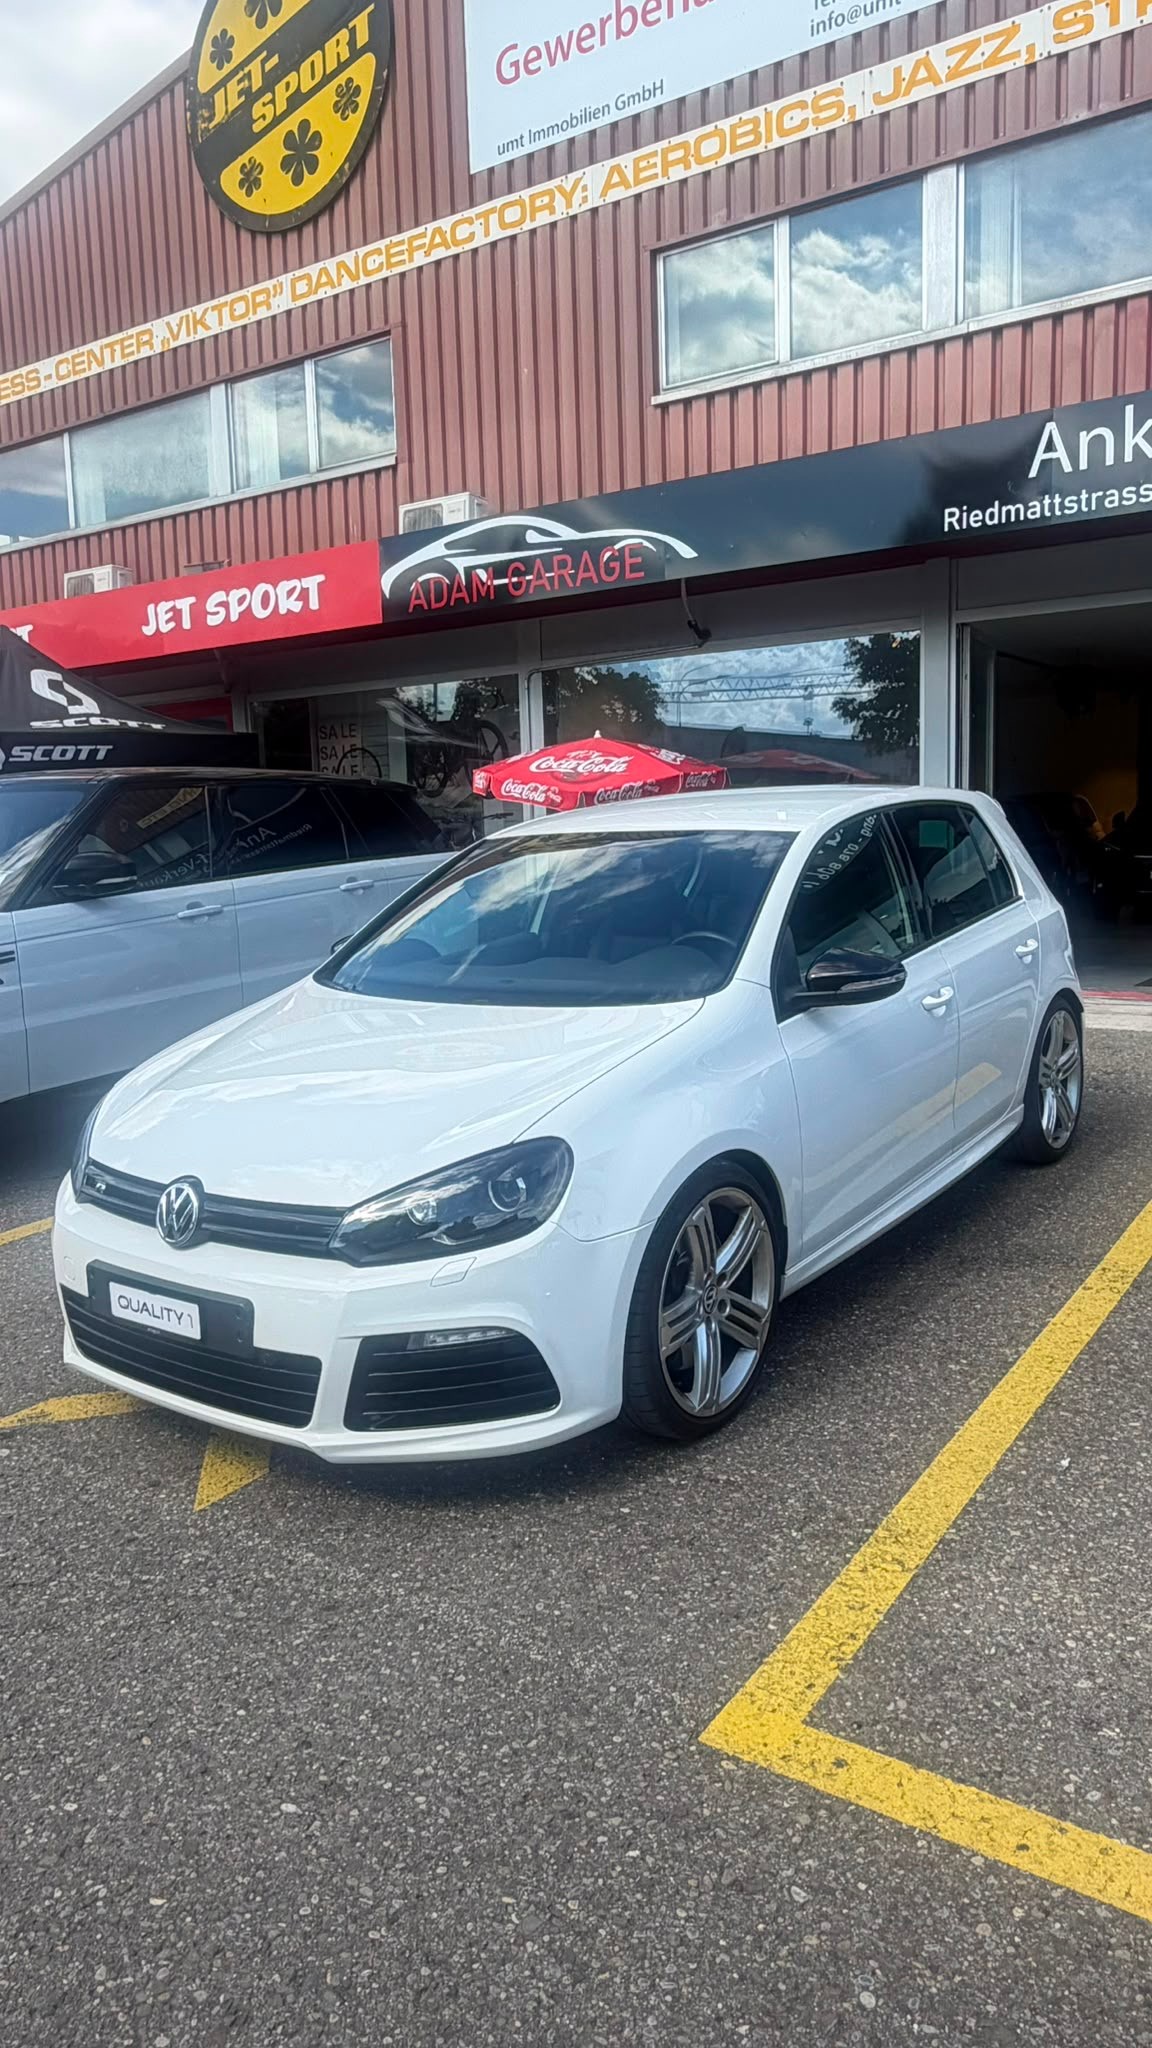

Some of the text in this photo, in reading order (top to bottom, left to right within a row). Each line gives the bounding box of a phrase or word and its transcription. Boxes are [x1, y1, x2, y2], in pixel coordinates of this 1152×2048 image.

[209, 51, 280, 129] JET-
[252, 3, 375, 133] SPORT
[497, 79, 664, 156] umt Immobilien GmbH
[290, 176, 588, 302] DANCEFACTORY:
[600, 86, 856, 199] AEROBICS,
[873, 23, 1036, 106] JAZZ,
[1028, 404, 1152, 479] Ank
[142, 574, 326, 636] JET SPORT
[408, 542, 645, 613] ADAM GARAGE
[9, 745, 113, 761] SCOTT
[30, 716, 166, 730] SCOTT
[320, 723, 357, 740] SALE
[320, 744, 358, 760] SALE
[117, 1295, 184, 1325] QUALITY
